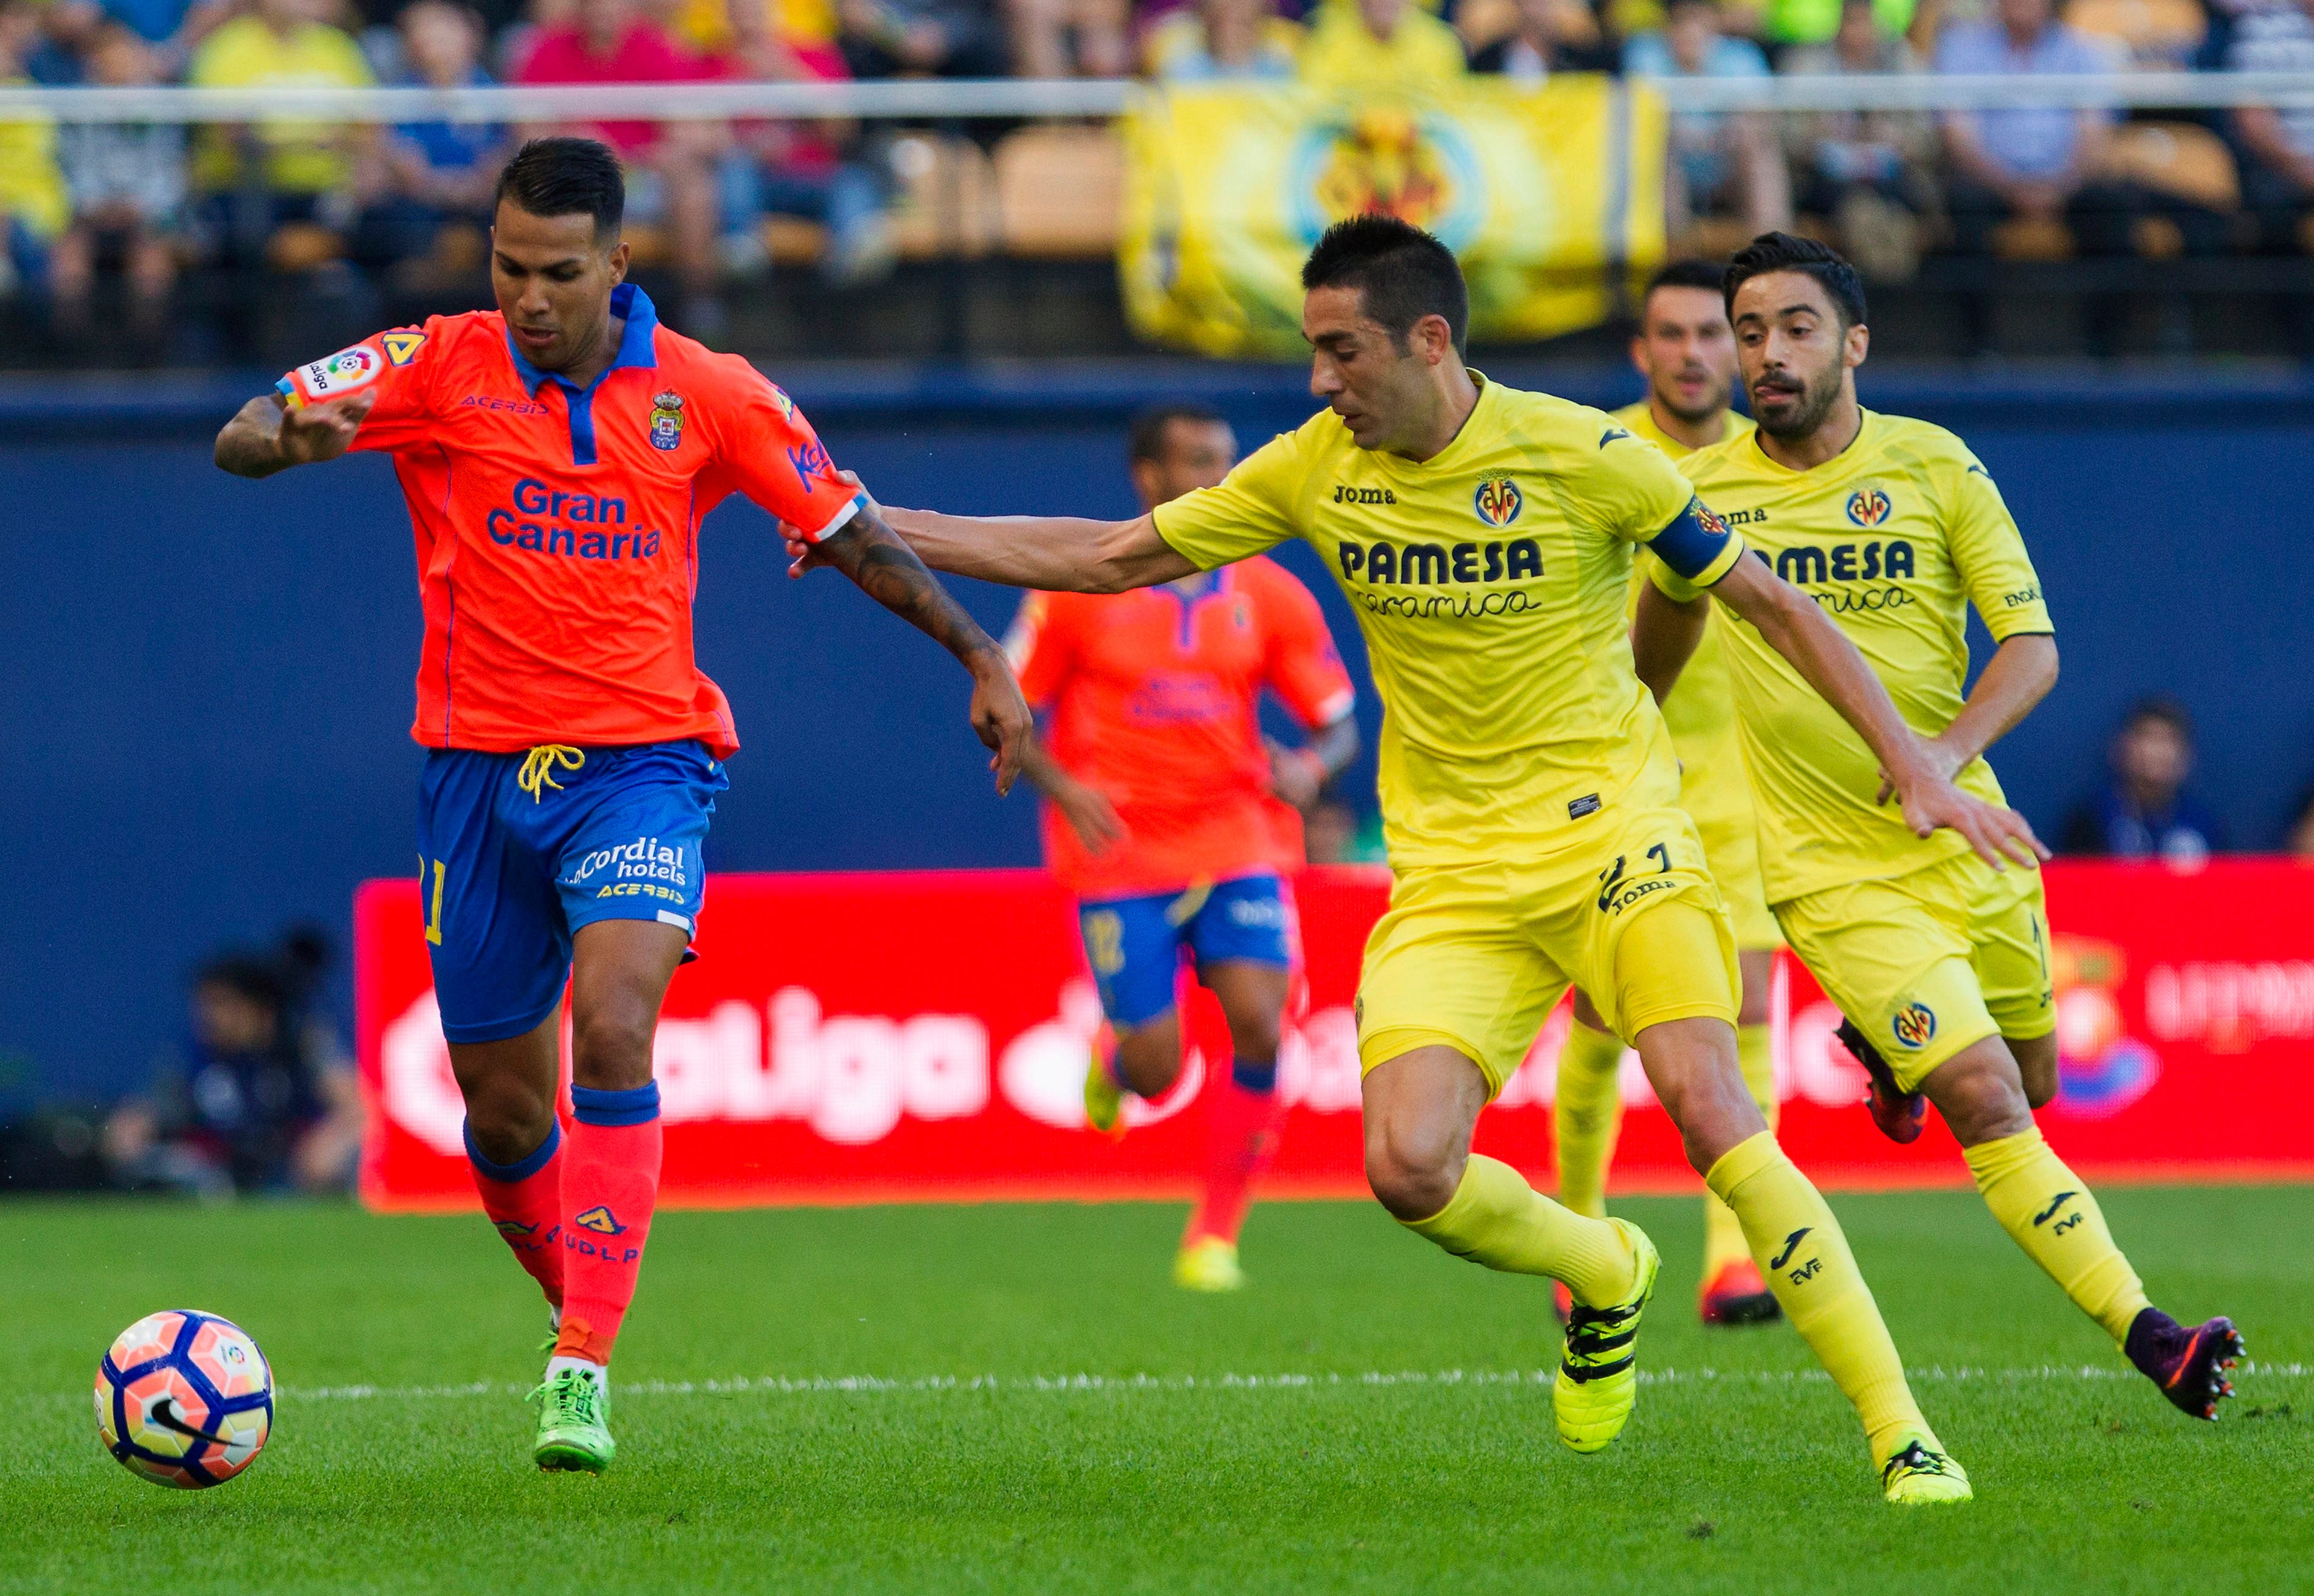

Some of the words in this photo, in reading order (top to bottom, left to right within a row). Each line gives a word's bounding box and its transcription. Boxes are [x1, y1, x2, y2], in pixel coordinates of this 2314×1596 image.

[513, 477, 626, 525] Gran
[1719, 509, 1768, 525] ma
[487, 507, 661, 560] Canaria
[1339, 538, 1544, 585] PAMESA
[1754, 540, 1915, 584] MESA
[581, 837, 684, 879] Cordial
[617, 860, 686, 886] hotels
[1612, 881, 1676, 916] Joma
[652, 985, 991, 1145] aLiga
[565, 1233, 639, 1264] UDLP
